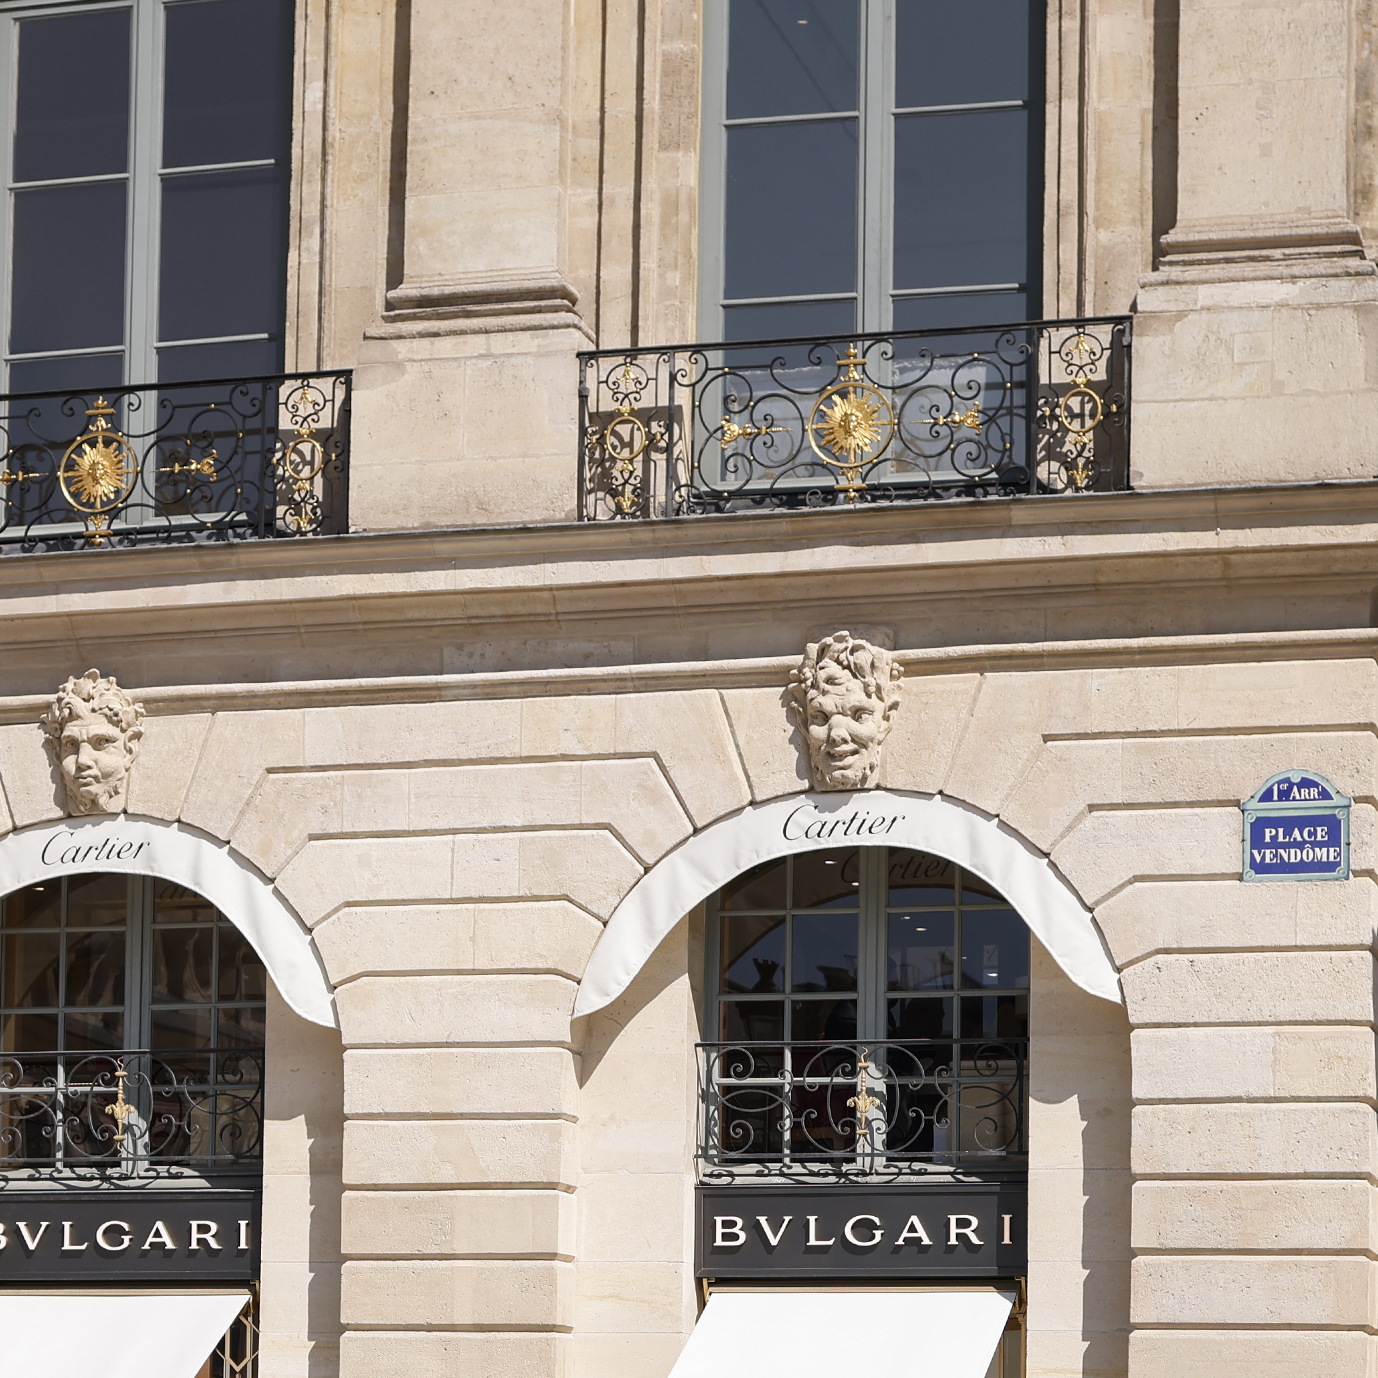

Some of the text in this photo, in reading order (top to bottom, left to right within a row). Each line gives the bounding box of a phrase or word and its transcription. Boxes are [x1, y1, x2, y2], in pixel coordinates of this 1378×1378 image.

[783, 804, 906, 840] Cartier
[1264, 826, 1328, 842] PLACE
[41, 831, 150, 865] Cartier
[1251, 844, 1340, 864] VENDÔME
[840, 850, 953, 884] Crtier
[713, 1214, 1013, 1247] BVLGARI
